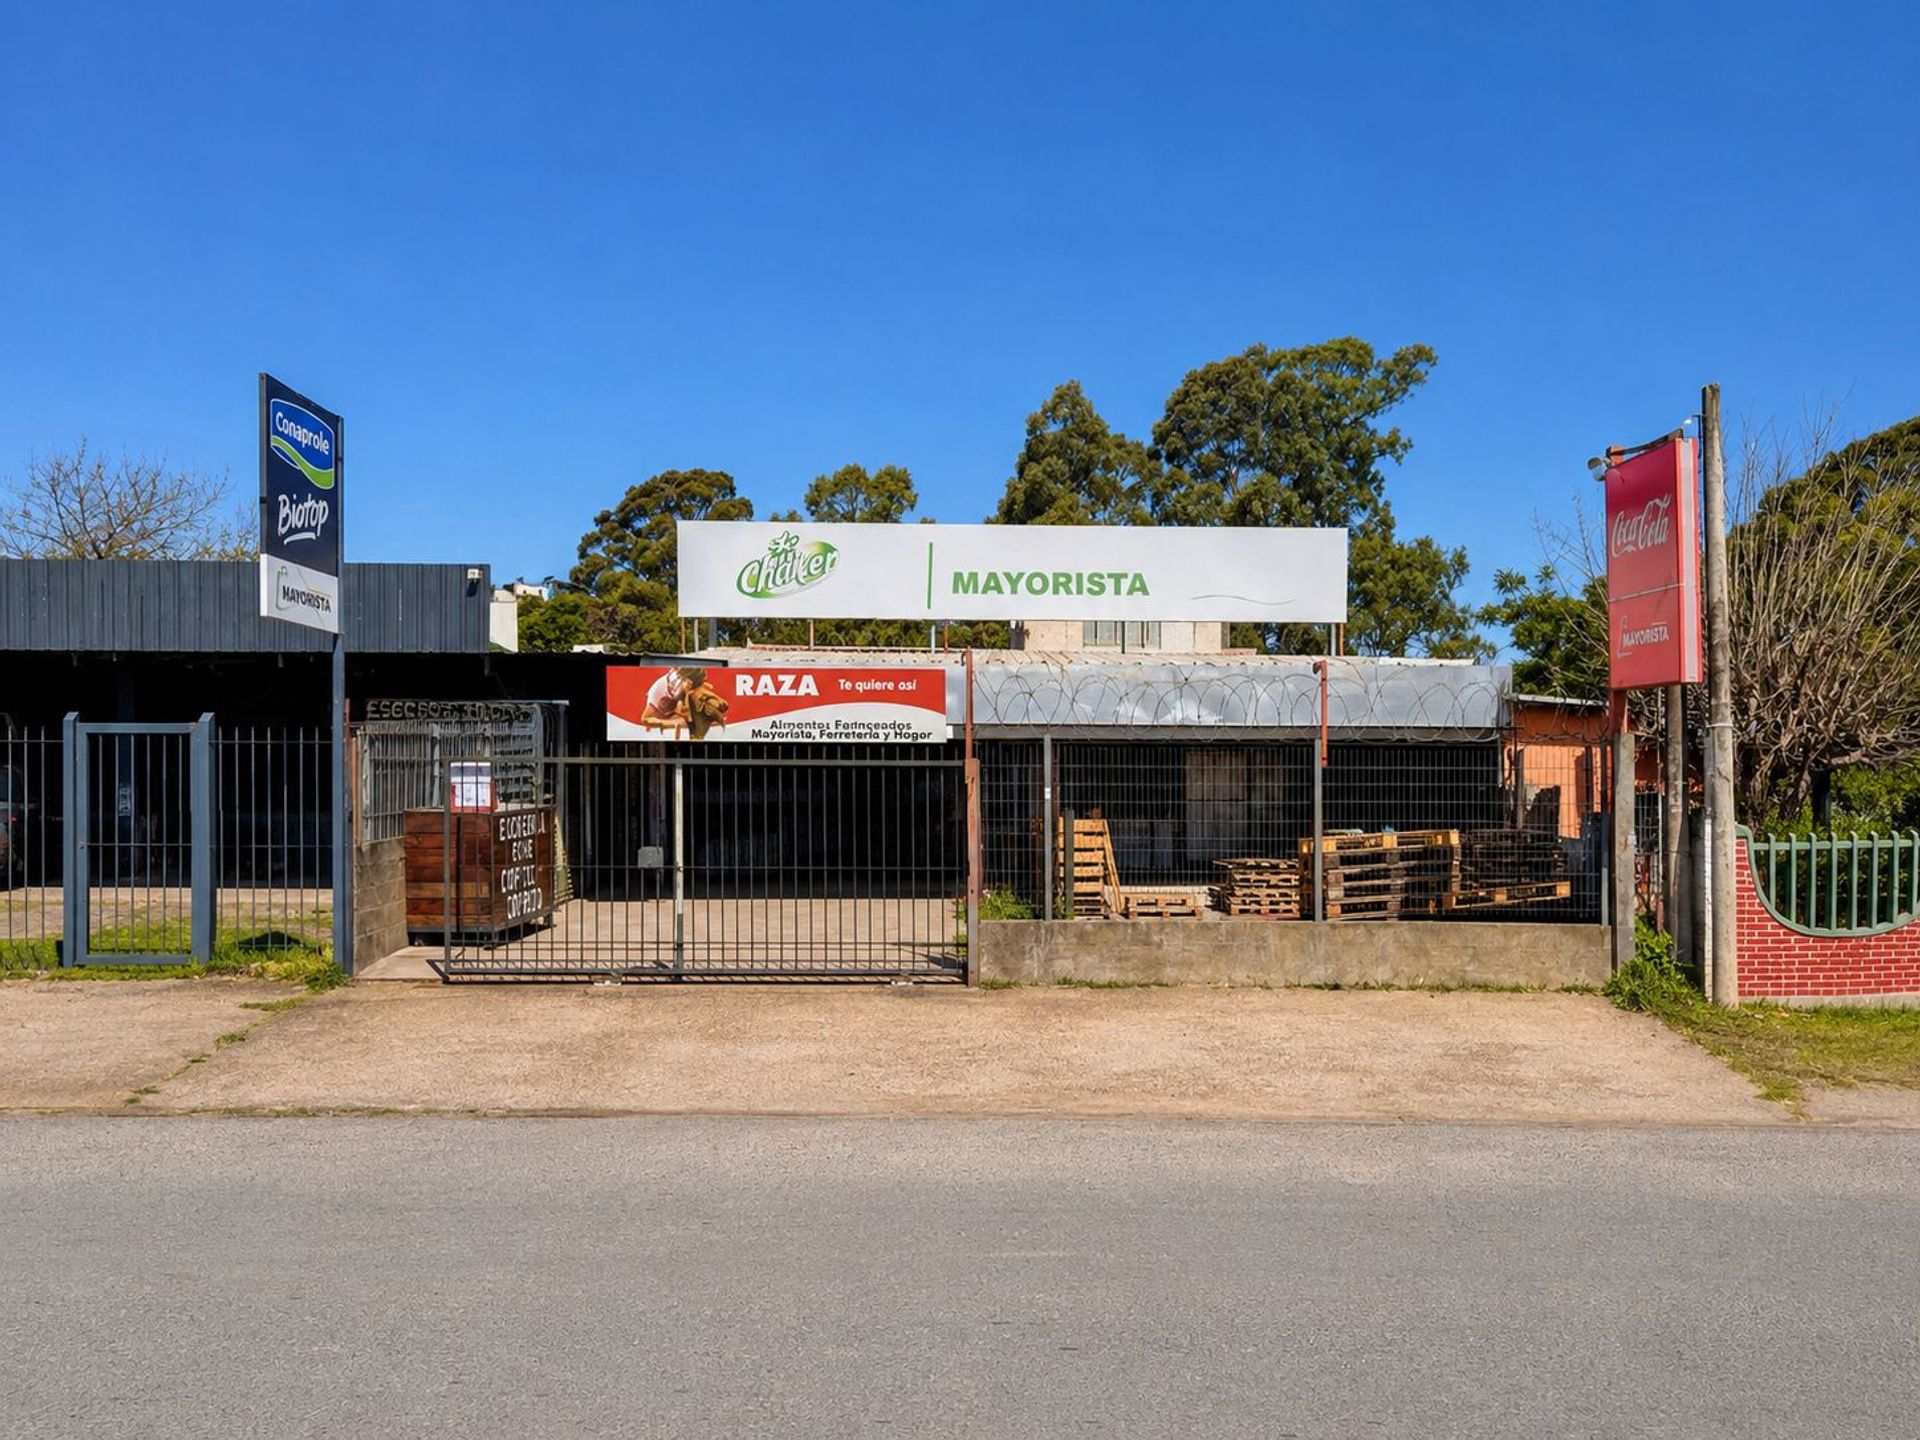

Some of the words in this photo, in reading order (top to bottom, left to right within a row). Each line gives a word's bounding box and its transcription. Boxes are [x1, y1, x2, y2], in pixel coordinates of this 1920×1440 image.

[275, 411, 330, 456] Conaprole
[277, 493, 329, 537] Biotop
[951, 571, 1150, 597] MAYORISTA
[282, 585, 332, 613] MAYORISTA
[1622, 626, 1669, 647] MAYORISTA
[735, 674, 819, 696] RAZA
[838, 679, 853, 690] Te
[855, 679, 894, 693] quiere
[882, 731, 891, 741] y
